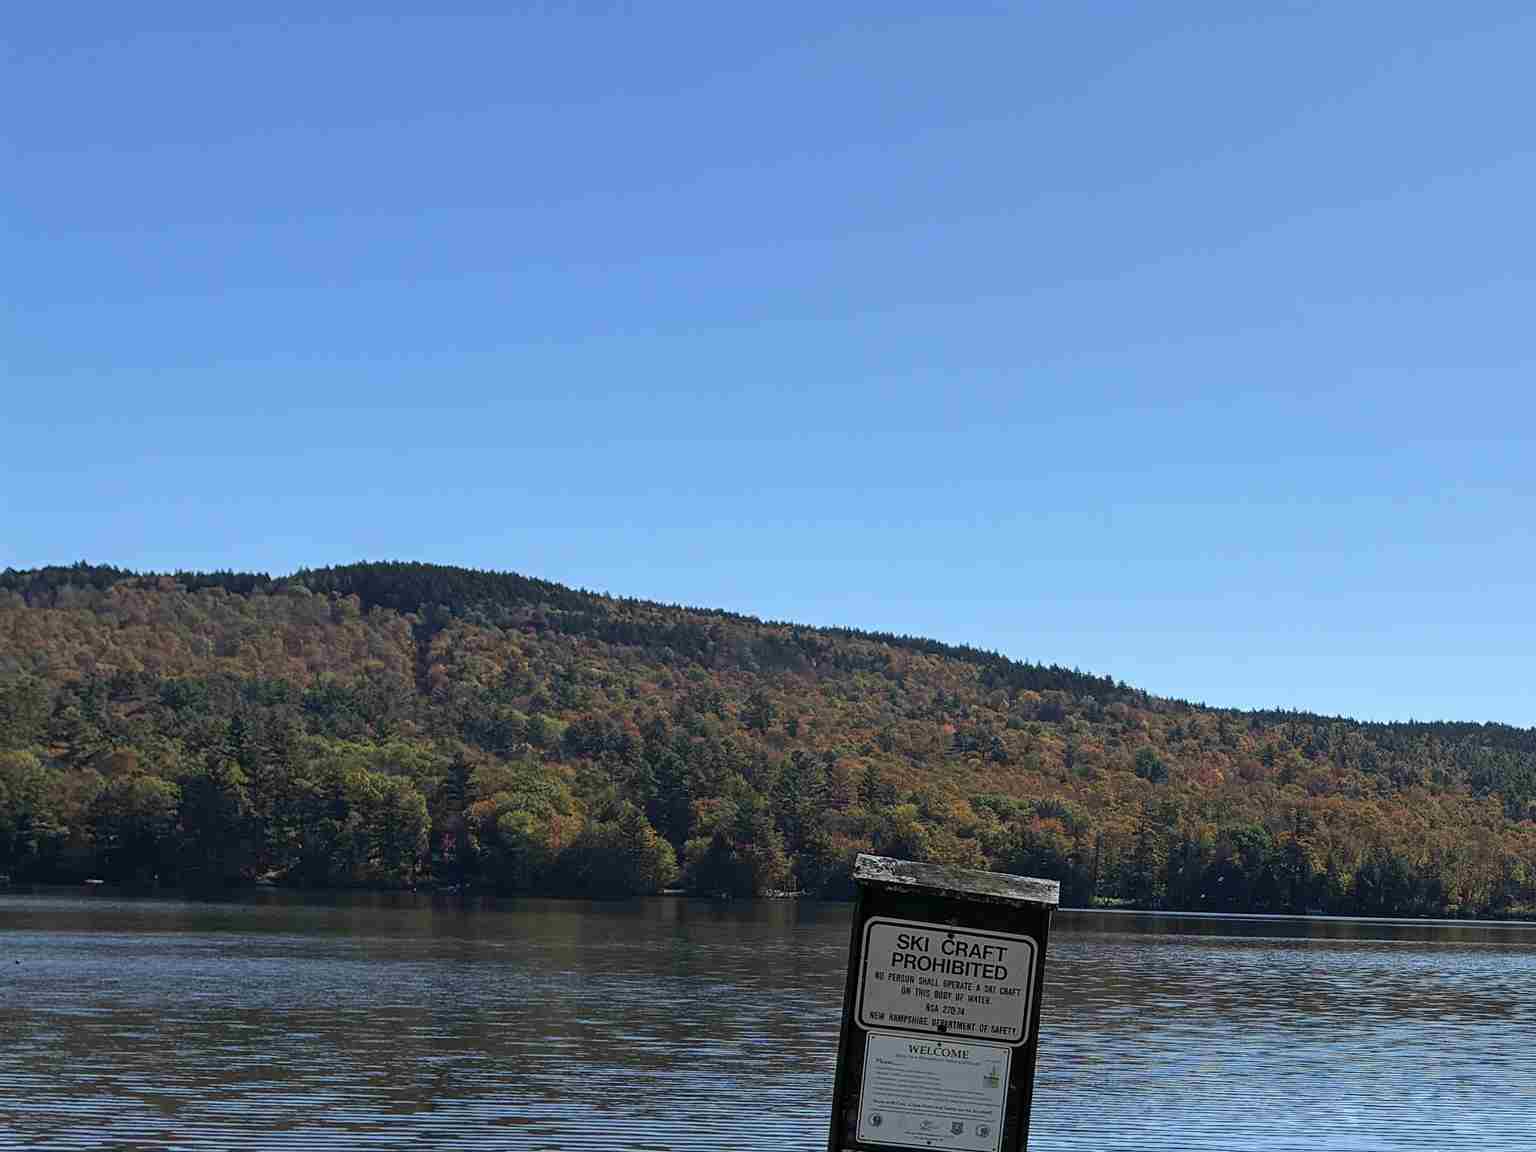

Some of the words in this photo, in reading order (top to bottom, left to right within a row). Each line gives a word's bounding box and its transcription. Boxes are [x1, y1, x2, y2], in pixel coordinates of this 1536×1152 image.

[896, 934, 929, 952] SKI
[941, 939, 1008, 962] CRAFT
[891, 952, 1008, 981] PROHIBITED
[875, 971, 885, 980] NO
[887, 972, 915, 985] PERSON
[918, 976, 939, 987] SHALL
[943, 979, 973, 991] OPERATE
[999, 986, 1021, 997] CRAFT
[915, 987, 930, 999] THIS
[869, 1011, 885, 1021] NEW
[888, 1014, 929, 1025] HAMPSHIRE
[932, 1017, 976, 1032] DEPARTMENT
[979, 1023, 989, 1033] OF
[908, 1044, 969, 1059] WELCOME
